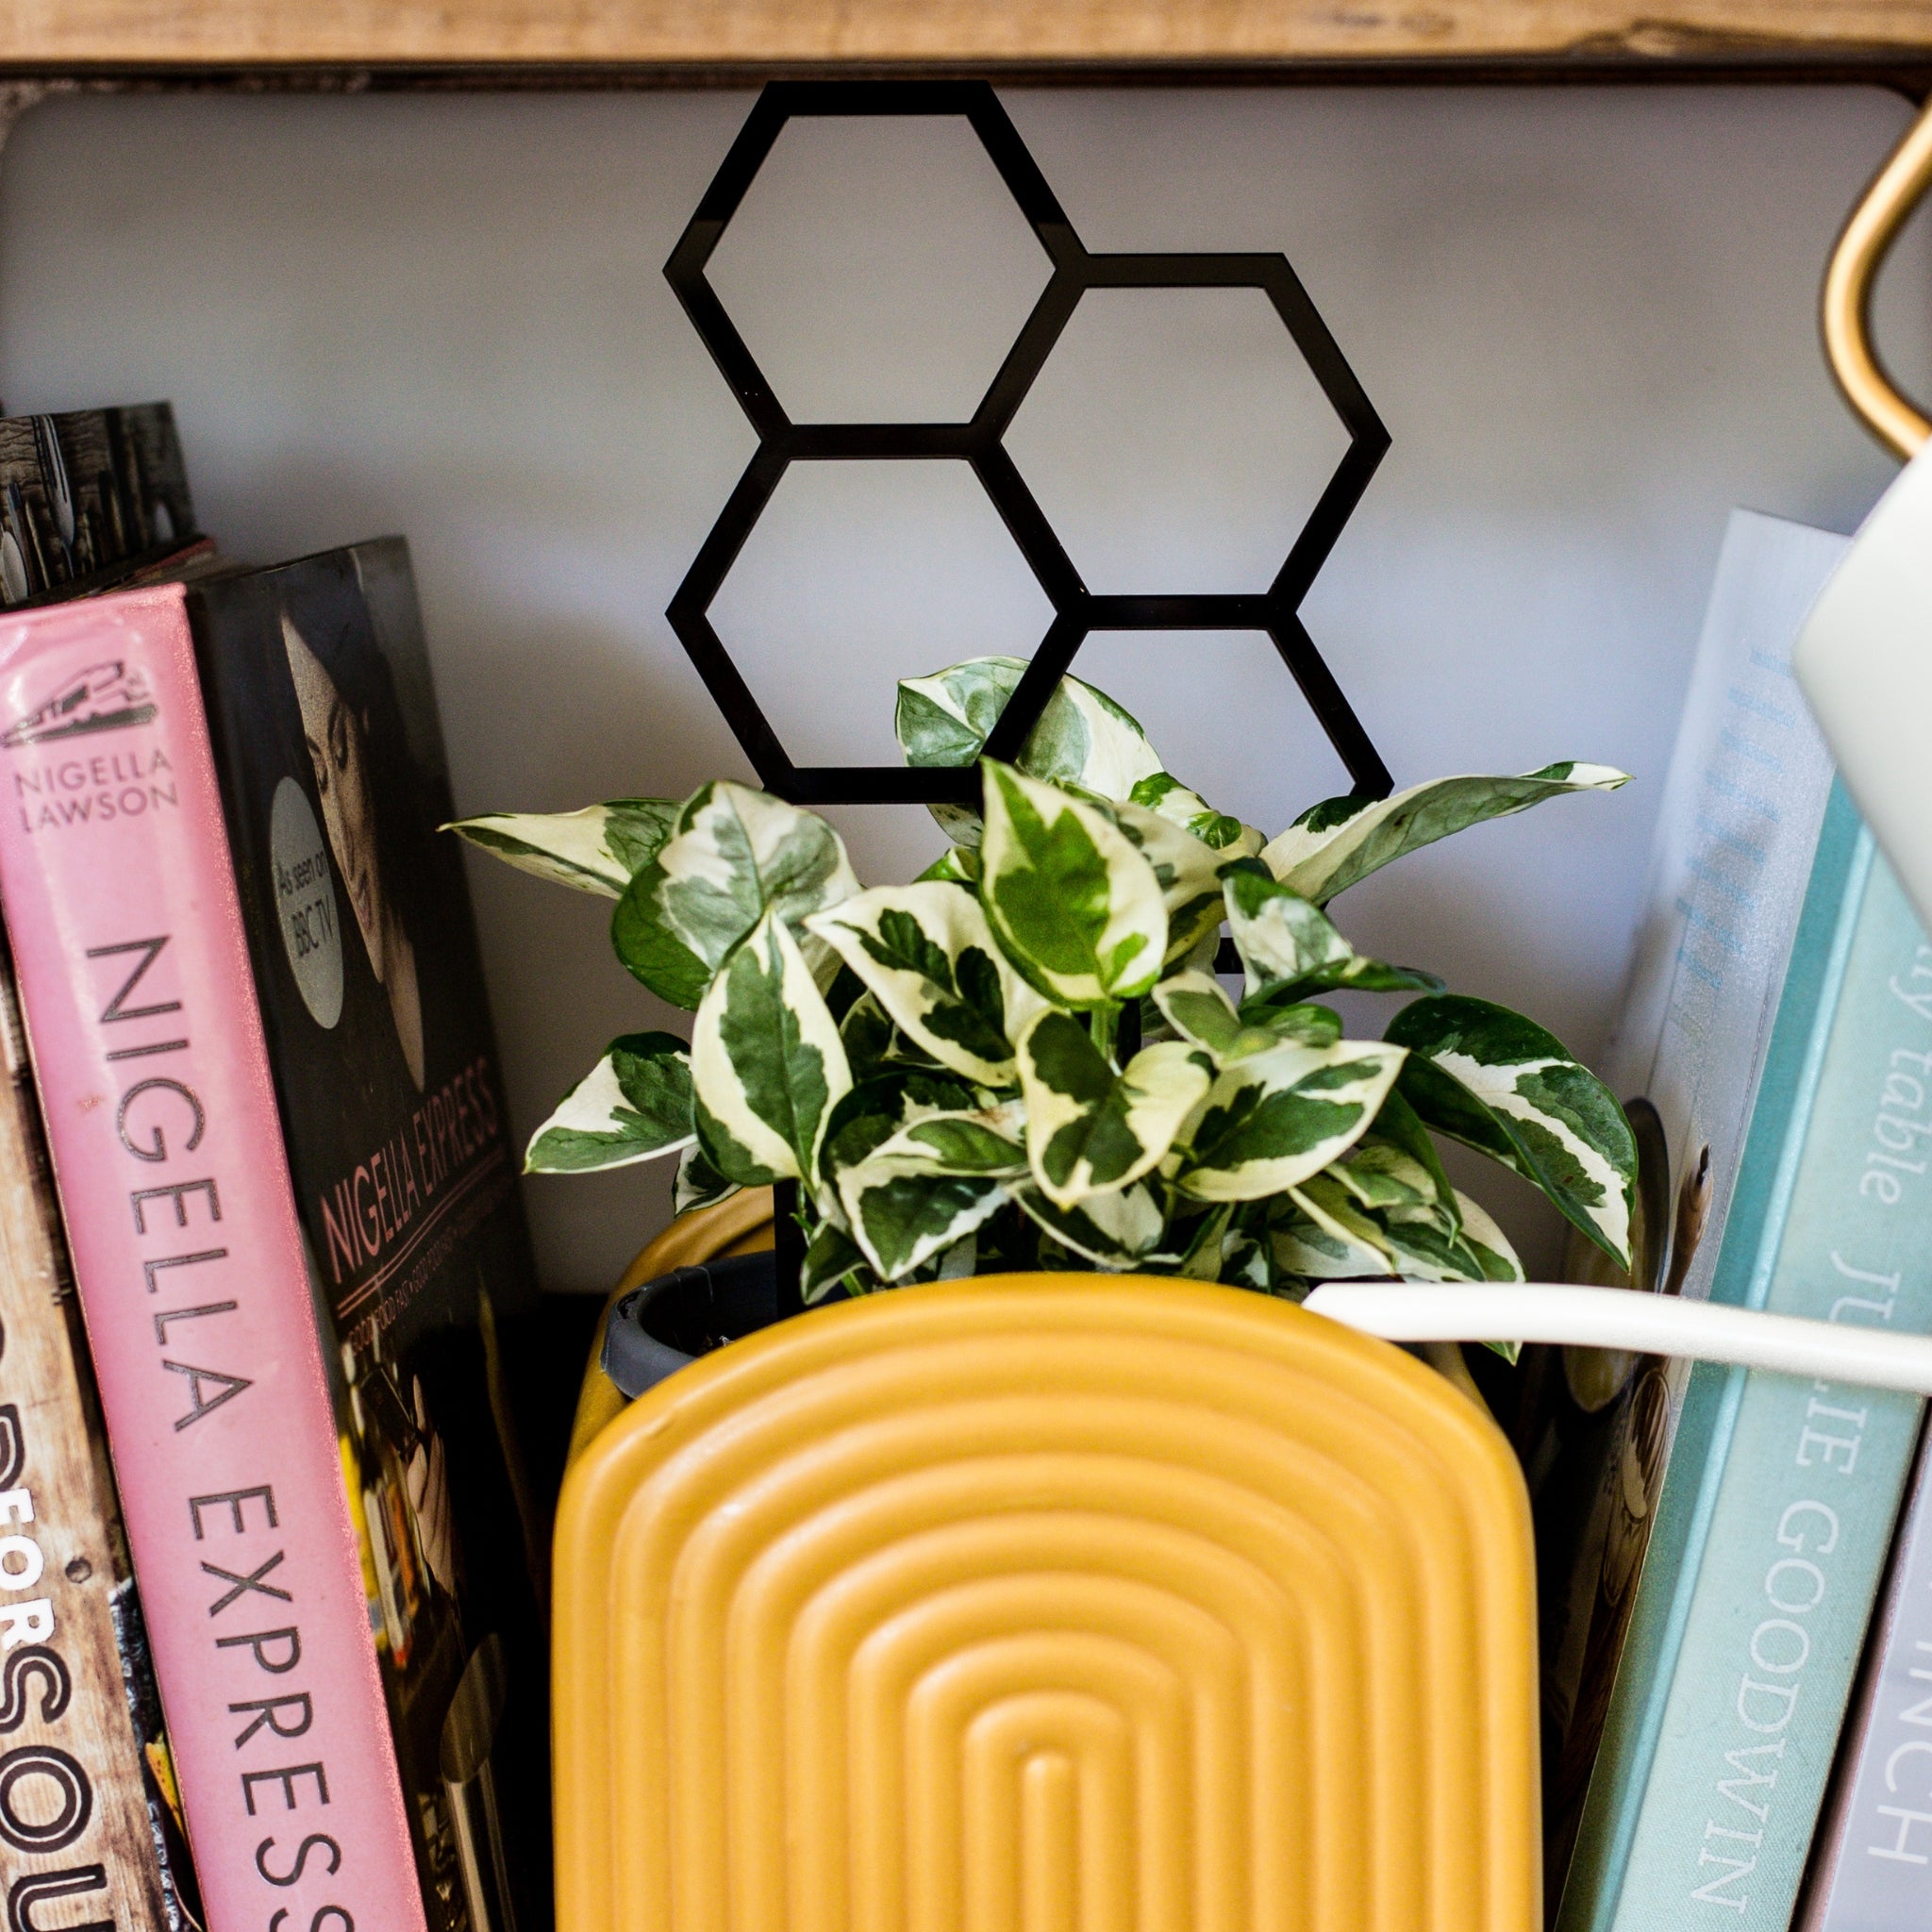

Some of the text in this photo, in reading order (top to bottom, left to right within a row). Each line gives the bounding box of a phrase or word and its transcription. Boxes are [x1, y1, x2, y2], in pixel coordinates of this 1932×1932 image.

[14, 748, 174, 798] NIGELLA
[19, 782, 179, 833] LAWSON
[291, 894, 333, 958] BBC TV
[292, 857, 316, 891] seen
[315, 850, 329, 878] on
[86, 934, 253, 1432] NIGELLA
[321, 1125, 421, 1284] NIGELLA
[412, 1057, 498, 1197] EXPRESS
[1859, 1046, 1932, 1206] table
[0, 1487, 56, 1652] FOR
[1690, 1249, 1902, 1915] JUIE GOODWIN
